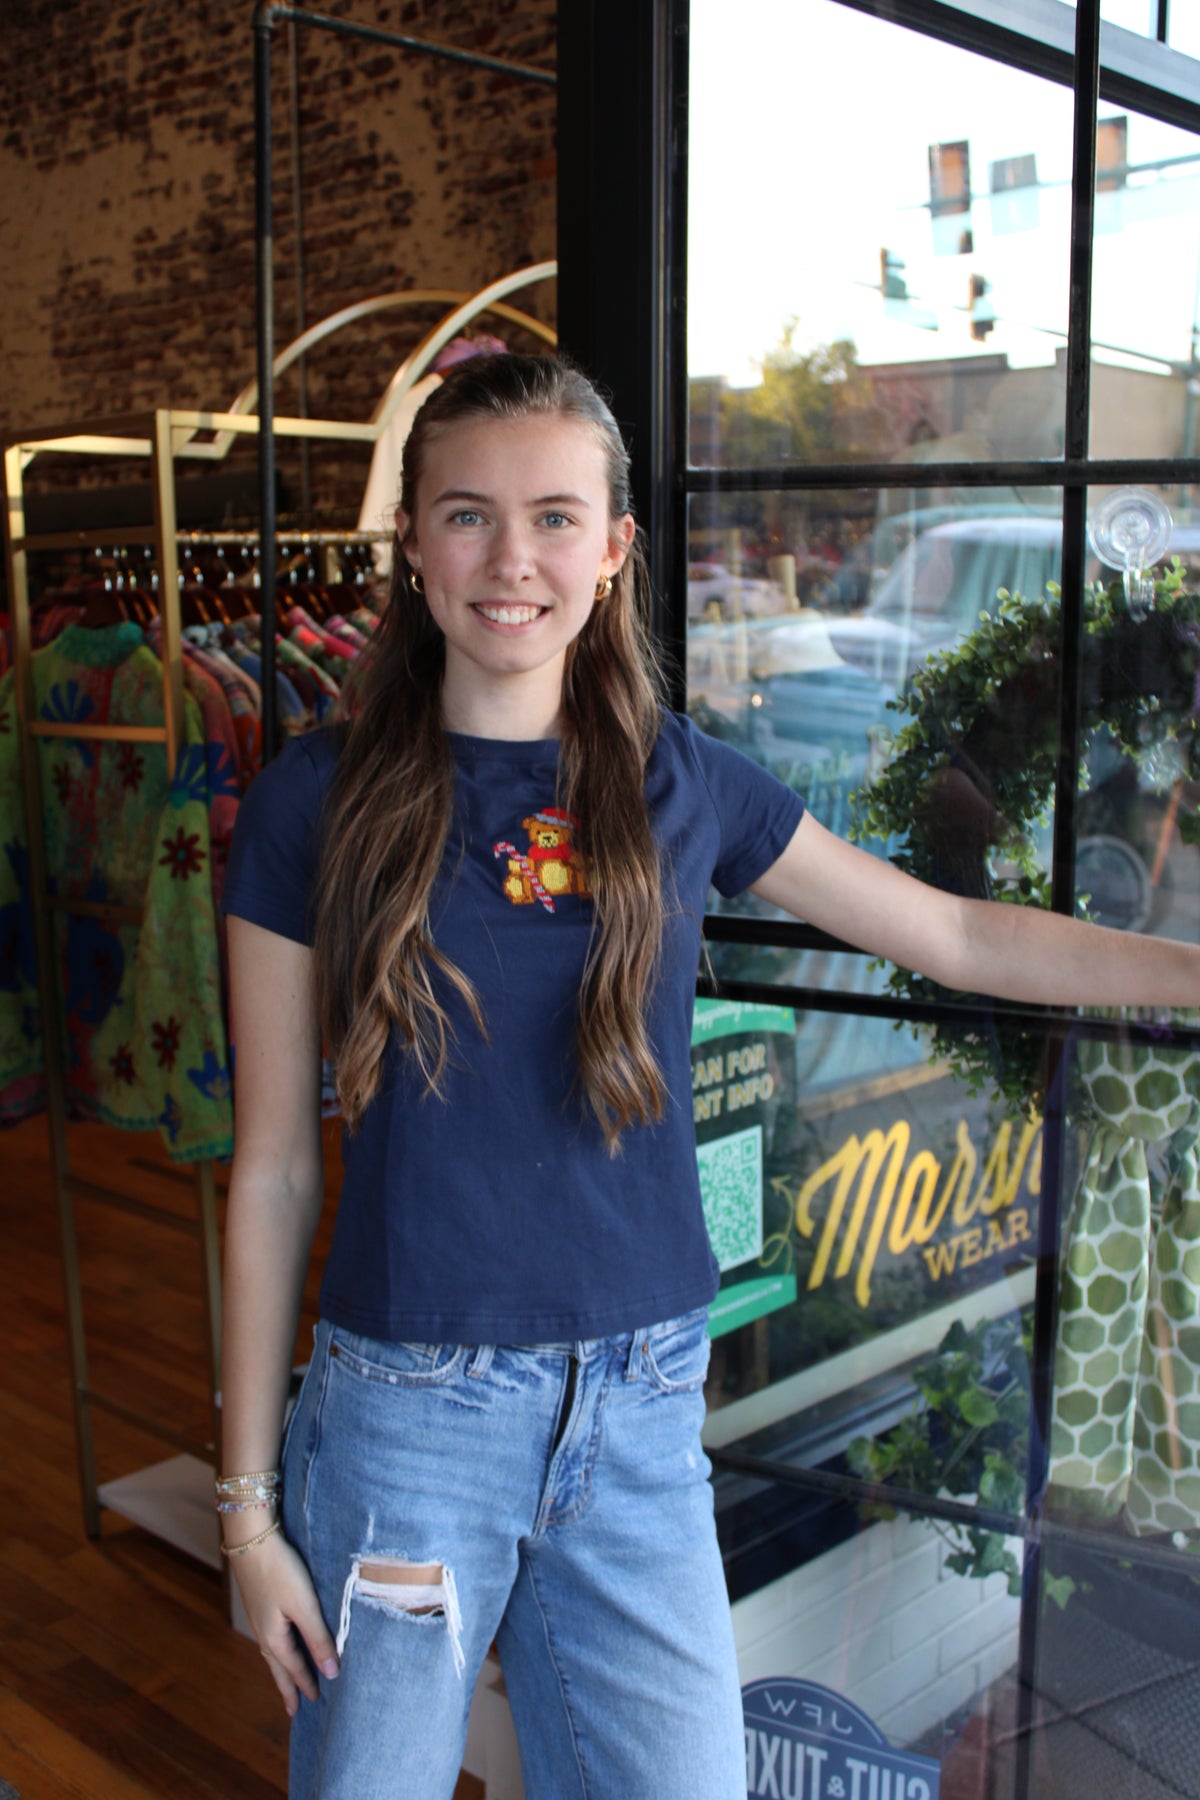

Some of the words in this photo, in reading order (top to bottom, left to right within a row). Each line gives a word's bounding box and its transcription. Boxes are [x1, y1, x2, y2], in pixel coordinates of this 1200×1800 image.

[690, 1056, 723, 1090] AN
[726, 1042, 766, 1079] FOR
[693, 1088, 724, 1123] NT
[727, 1073, 774, 1112] INFO
[922, 1208, 1033, 1281] WEAR
